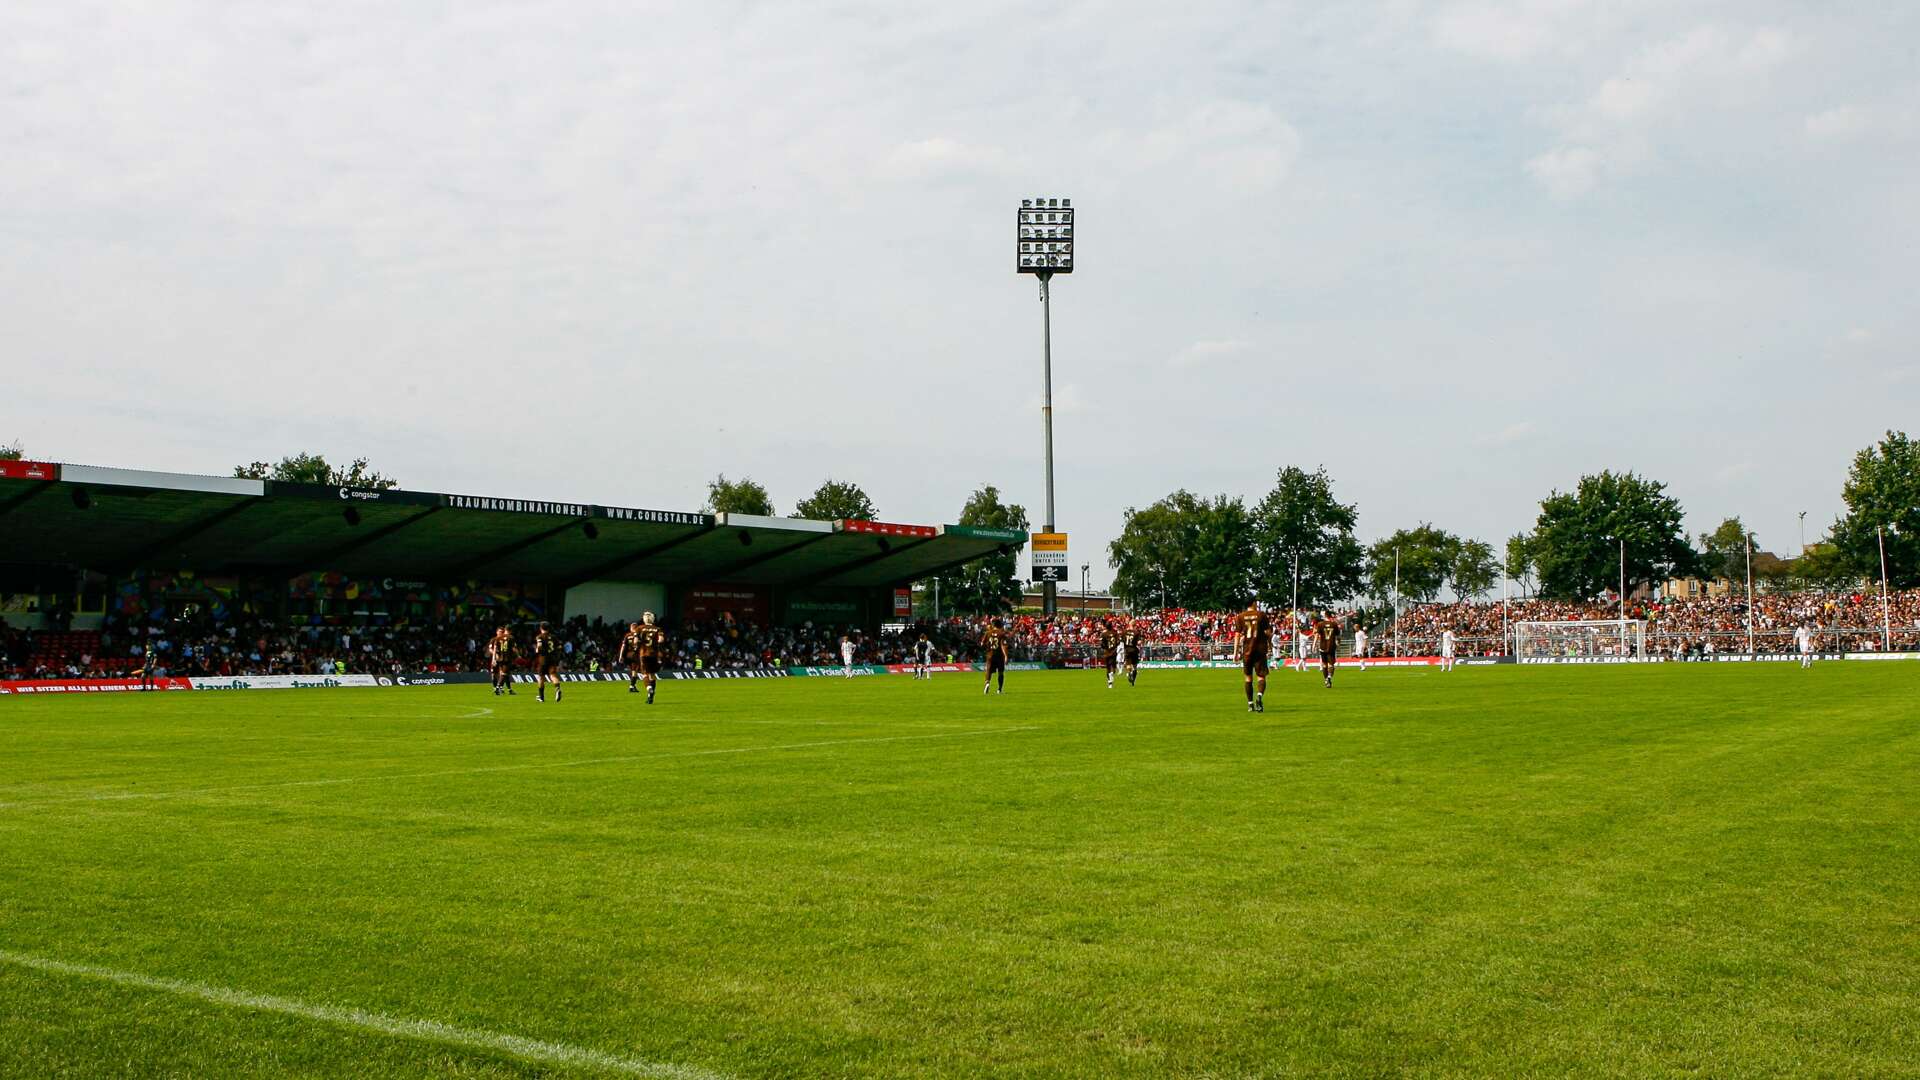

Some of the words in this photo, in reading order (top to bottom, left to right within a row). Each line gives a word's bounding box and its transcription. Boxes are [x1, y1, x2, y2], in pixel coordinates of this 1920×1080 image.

[351, 491, 380, 500] congstar
[449, 495, 588, 516] TRAUMKOMBINATIONEN:
[606, 508, 704, 525] WWW.CONGSTAR.DE
[547, 640, 555, 653] 3
[602, 672, 631, 682] UND
[702, 671, 721, 679] DU
